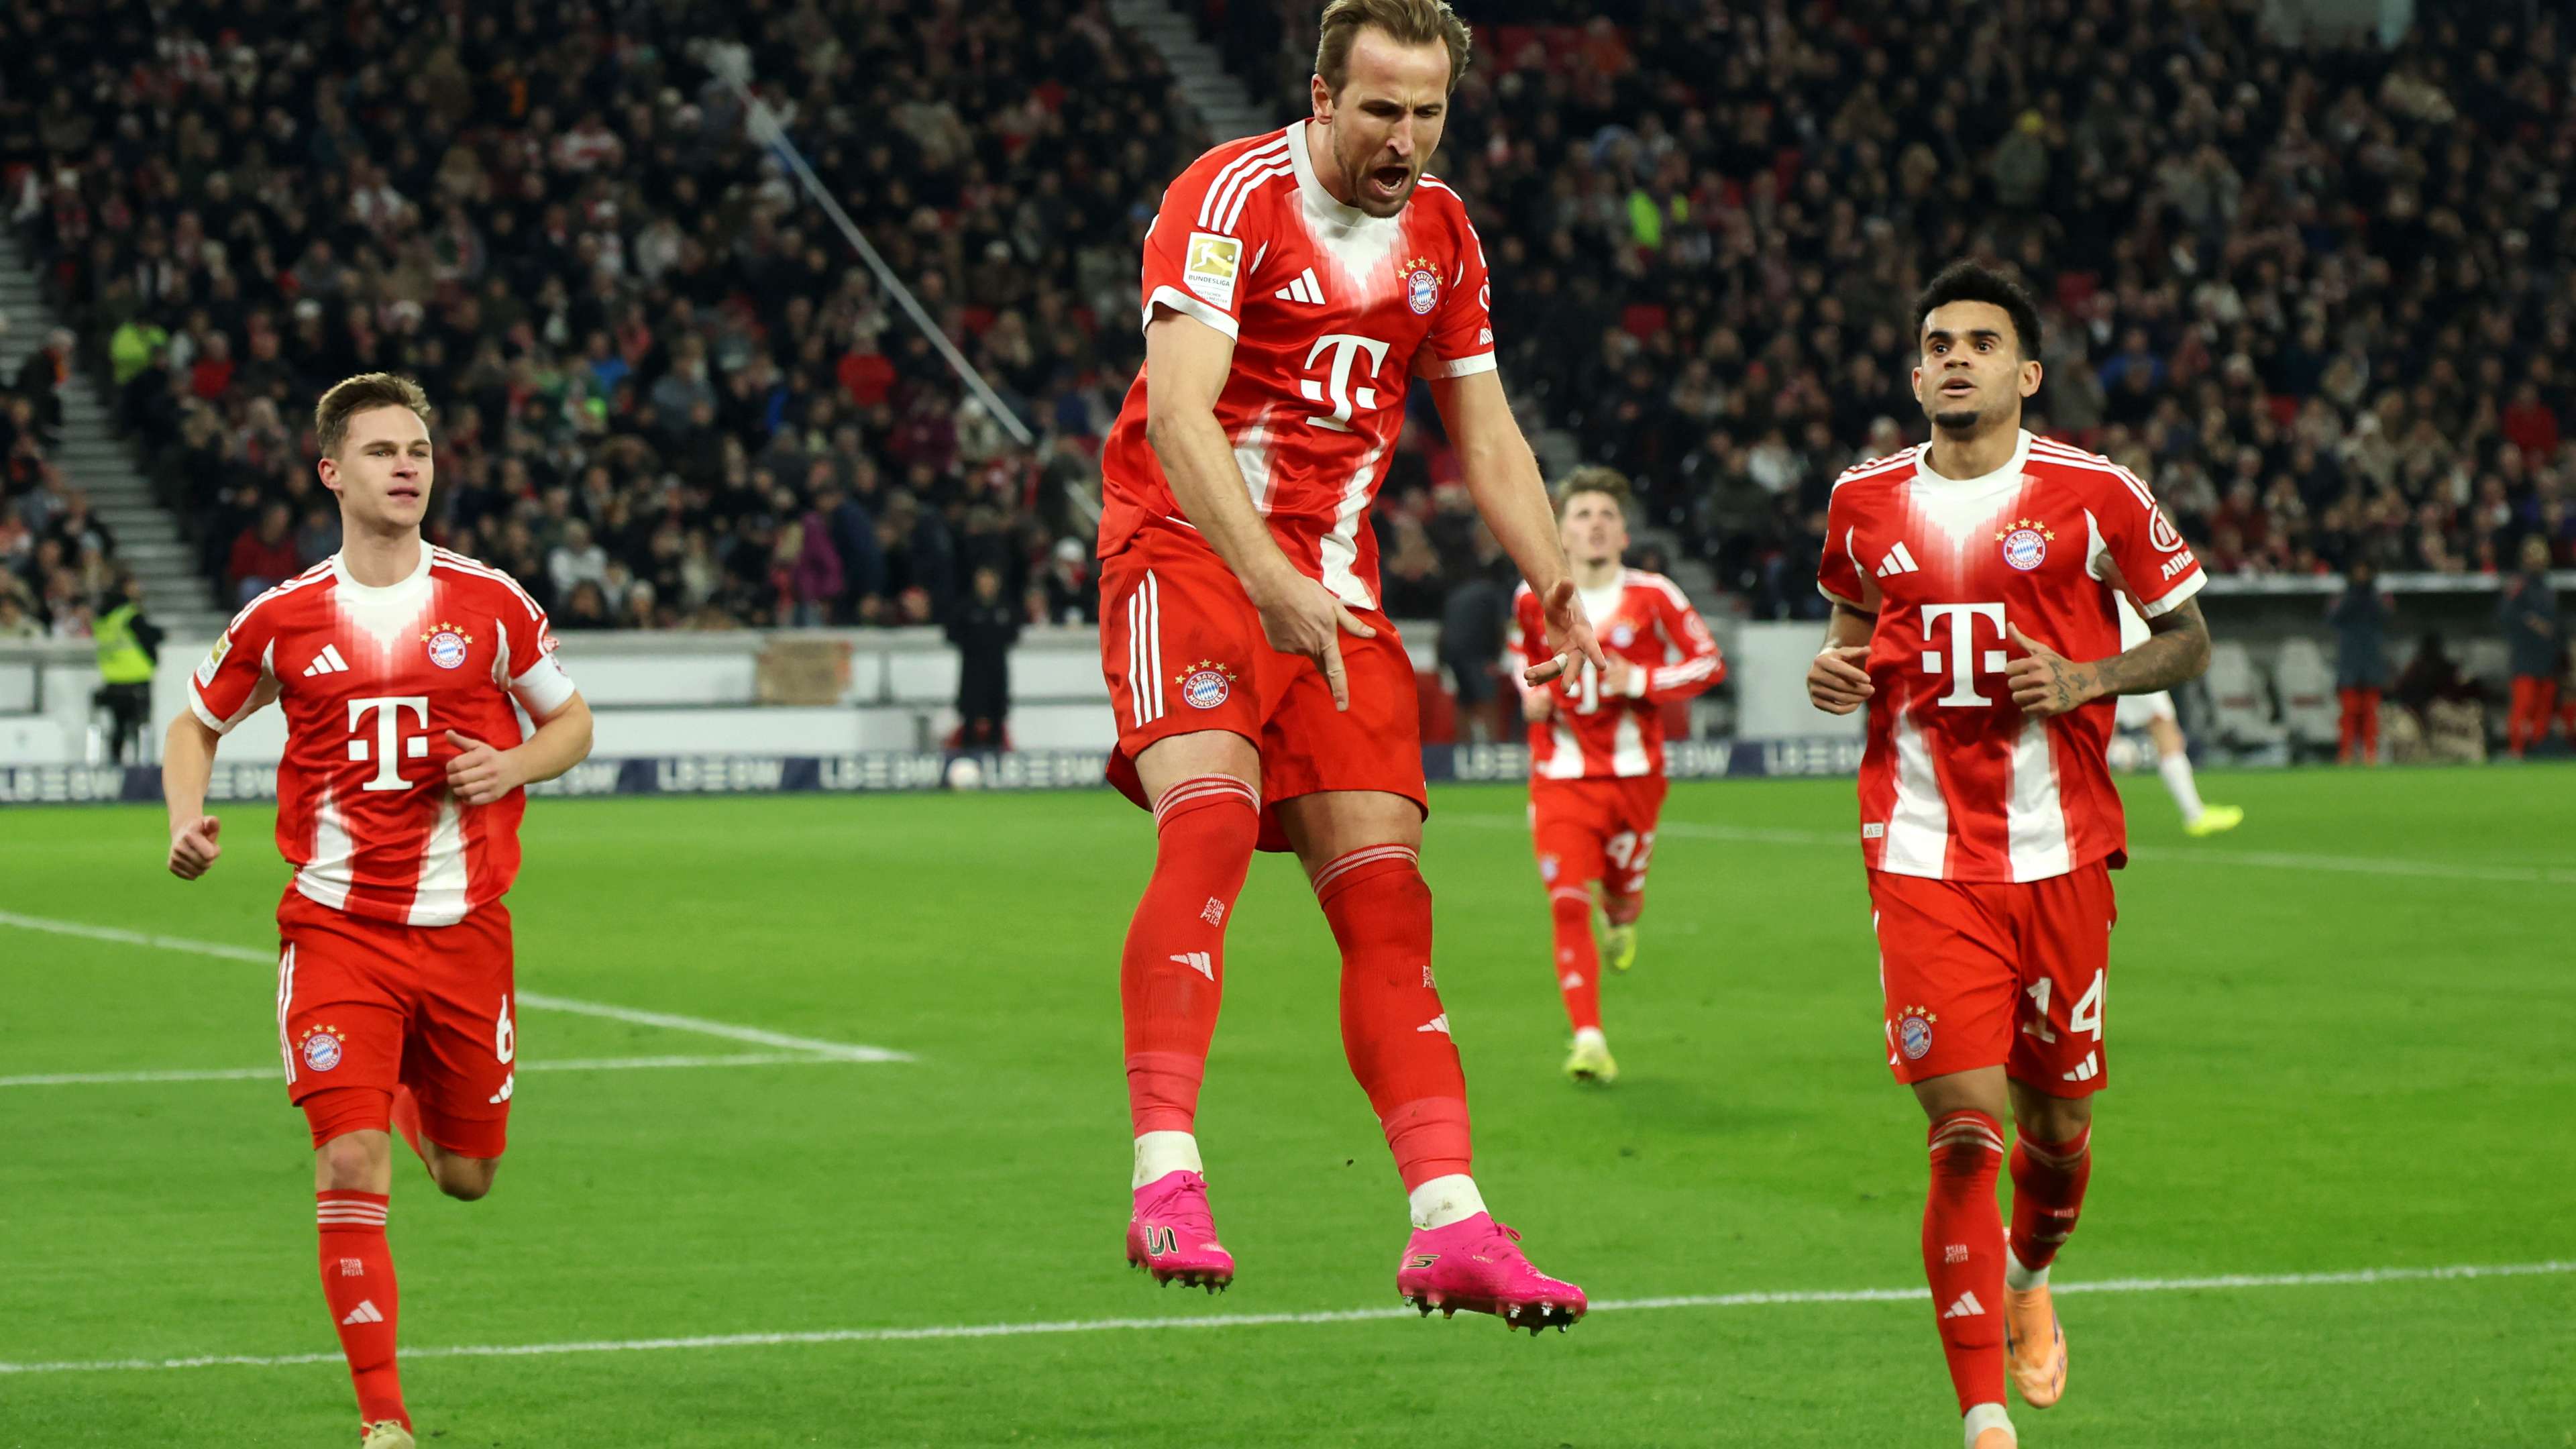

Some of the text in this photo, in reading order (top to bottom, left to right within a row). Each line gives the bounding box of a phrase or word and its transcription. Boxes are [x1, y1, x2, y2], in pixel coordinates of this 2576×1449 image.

[1188, 274, 1230, 286] BUNDESLIGA
[1416, 273, 1435, 291] BAYERN
[1301, 334, 1390, 432] T
[2016, 533, 2042, 547] BAYERN
[2161, 550, 2195, 582] Allia
[1921, 602, 2007, 706] T
[1196, 674, 1225, 688] BAYERN
[348, 696, 429, 790] T
[1208, 896, 1225, 912] MIA
[1200, 909, 1220, 928] MIA
[2022, 967, 2103, 1044] 14
[496, 994, 515, 1065] 6
